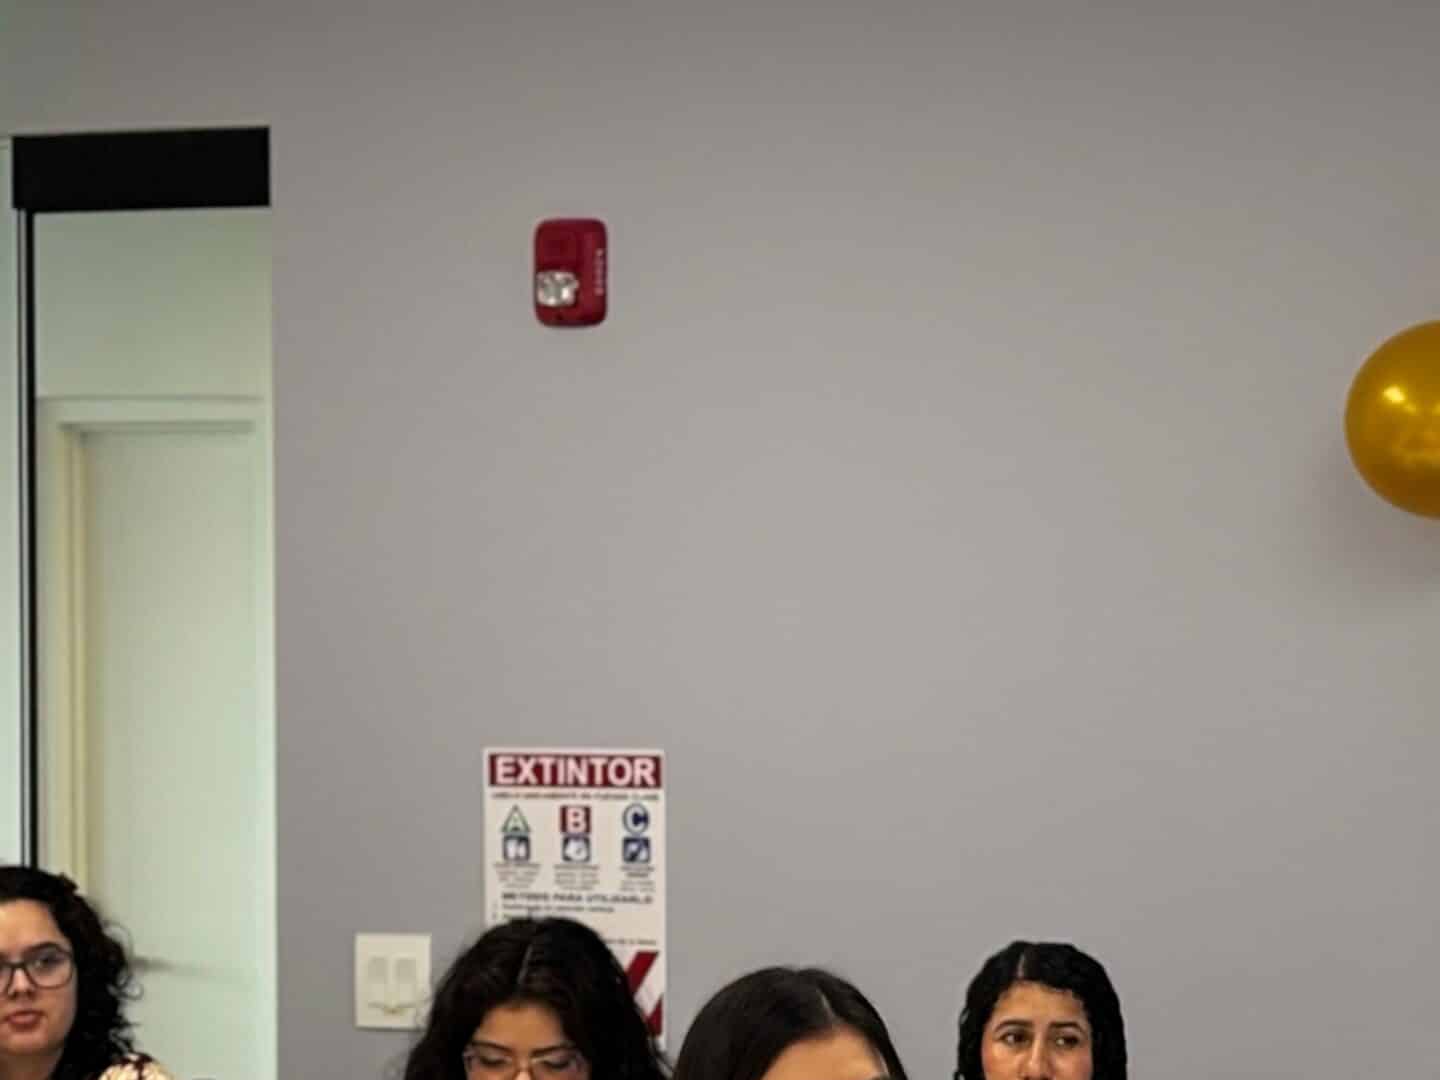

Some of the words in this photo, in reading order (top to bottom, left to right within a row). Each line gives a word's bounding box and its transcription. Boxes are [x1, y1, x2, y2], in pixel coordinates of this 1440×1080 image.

[494, 755, 656, 786] EXTINTOR
[565, 805, 588, 833] B
[623, 803, 649, 834] C
